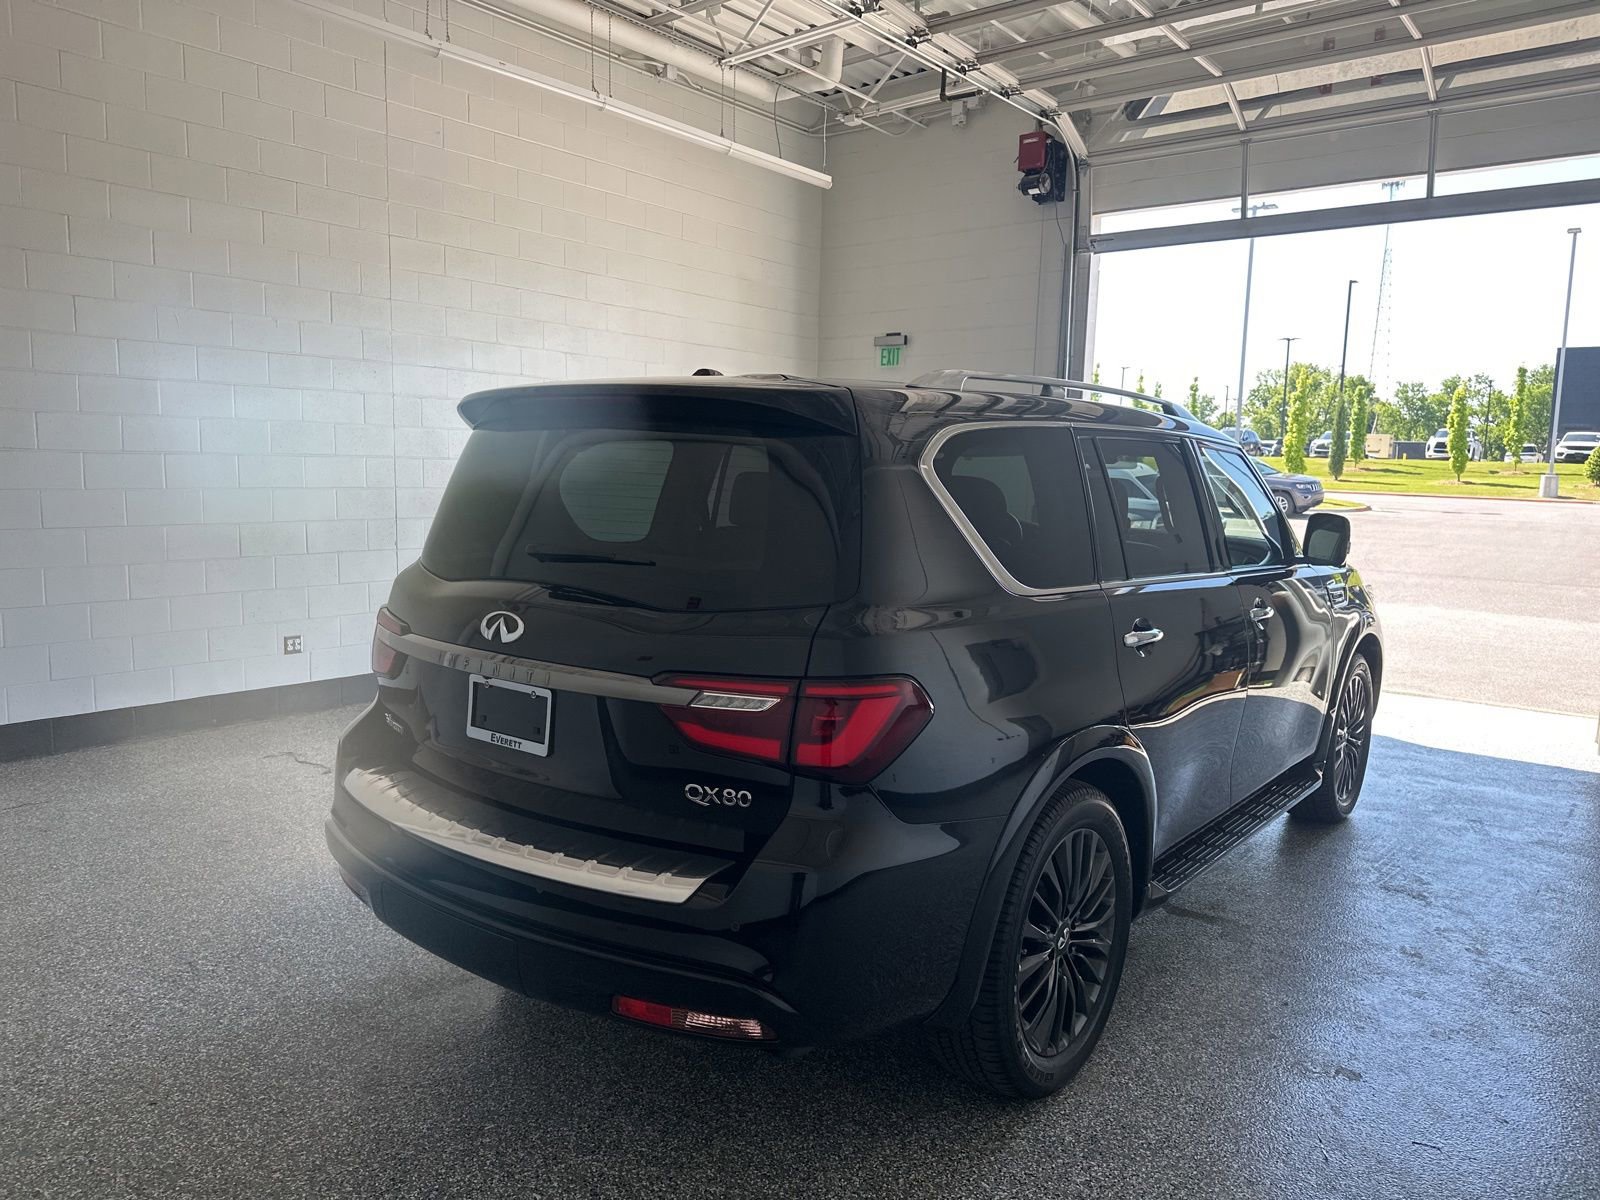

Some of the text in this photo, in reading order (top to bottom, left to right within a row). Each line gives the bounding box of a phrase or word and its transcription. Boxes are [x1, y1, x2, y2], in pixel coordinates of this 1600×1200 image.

[881, 348, 901, 366] EXIT
[438, 651, 550, 685] INFINITI
[684, 783, 752, 808] QX80
